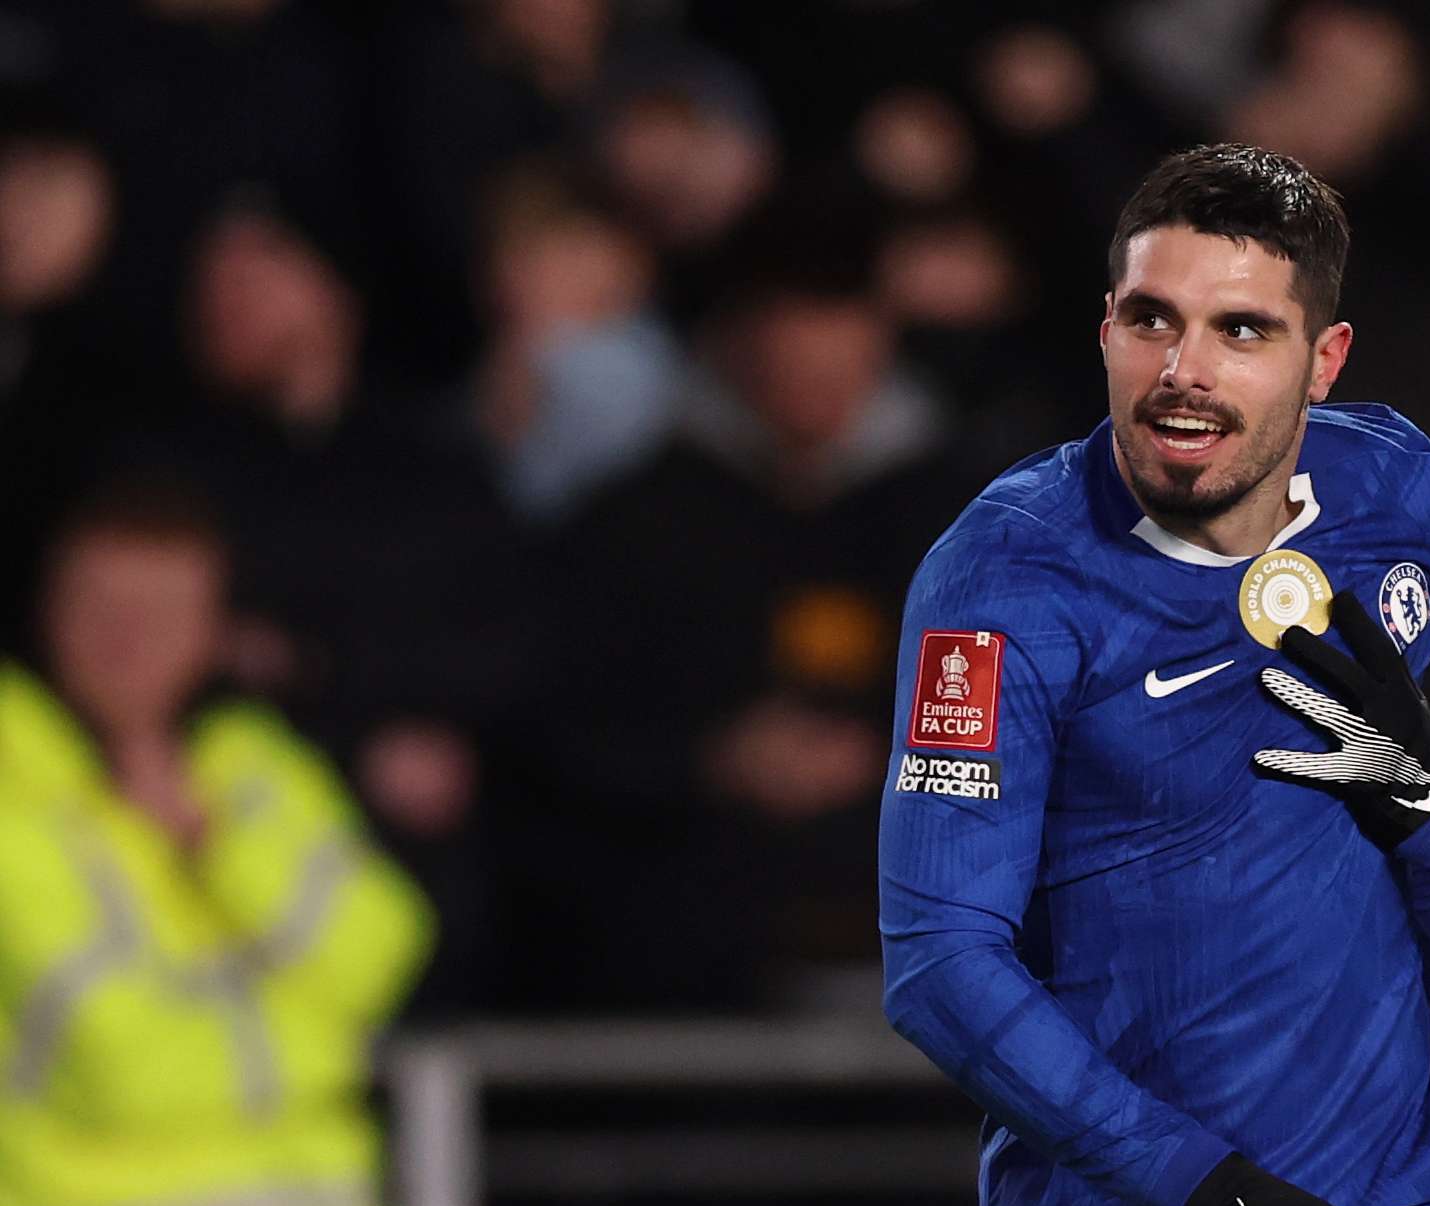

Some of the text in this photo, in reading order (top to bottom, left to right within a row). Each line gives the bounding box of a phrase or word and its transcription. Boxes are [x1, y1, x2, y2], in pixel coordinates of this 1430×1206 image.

[1247, 558, 1324, 622] WORLD CHAMPIONS
[1385, 566, 1423, 592] CHELSEA
[922, 702, 983, 719] Emirates
[921, 718, 984, 735] FA CUP
[901, 754, 990, 780] No room
[895, 773, 999, 800] for racism
